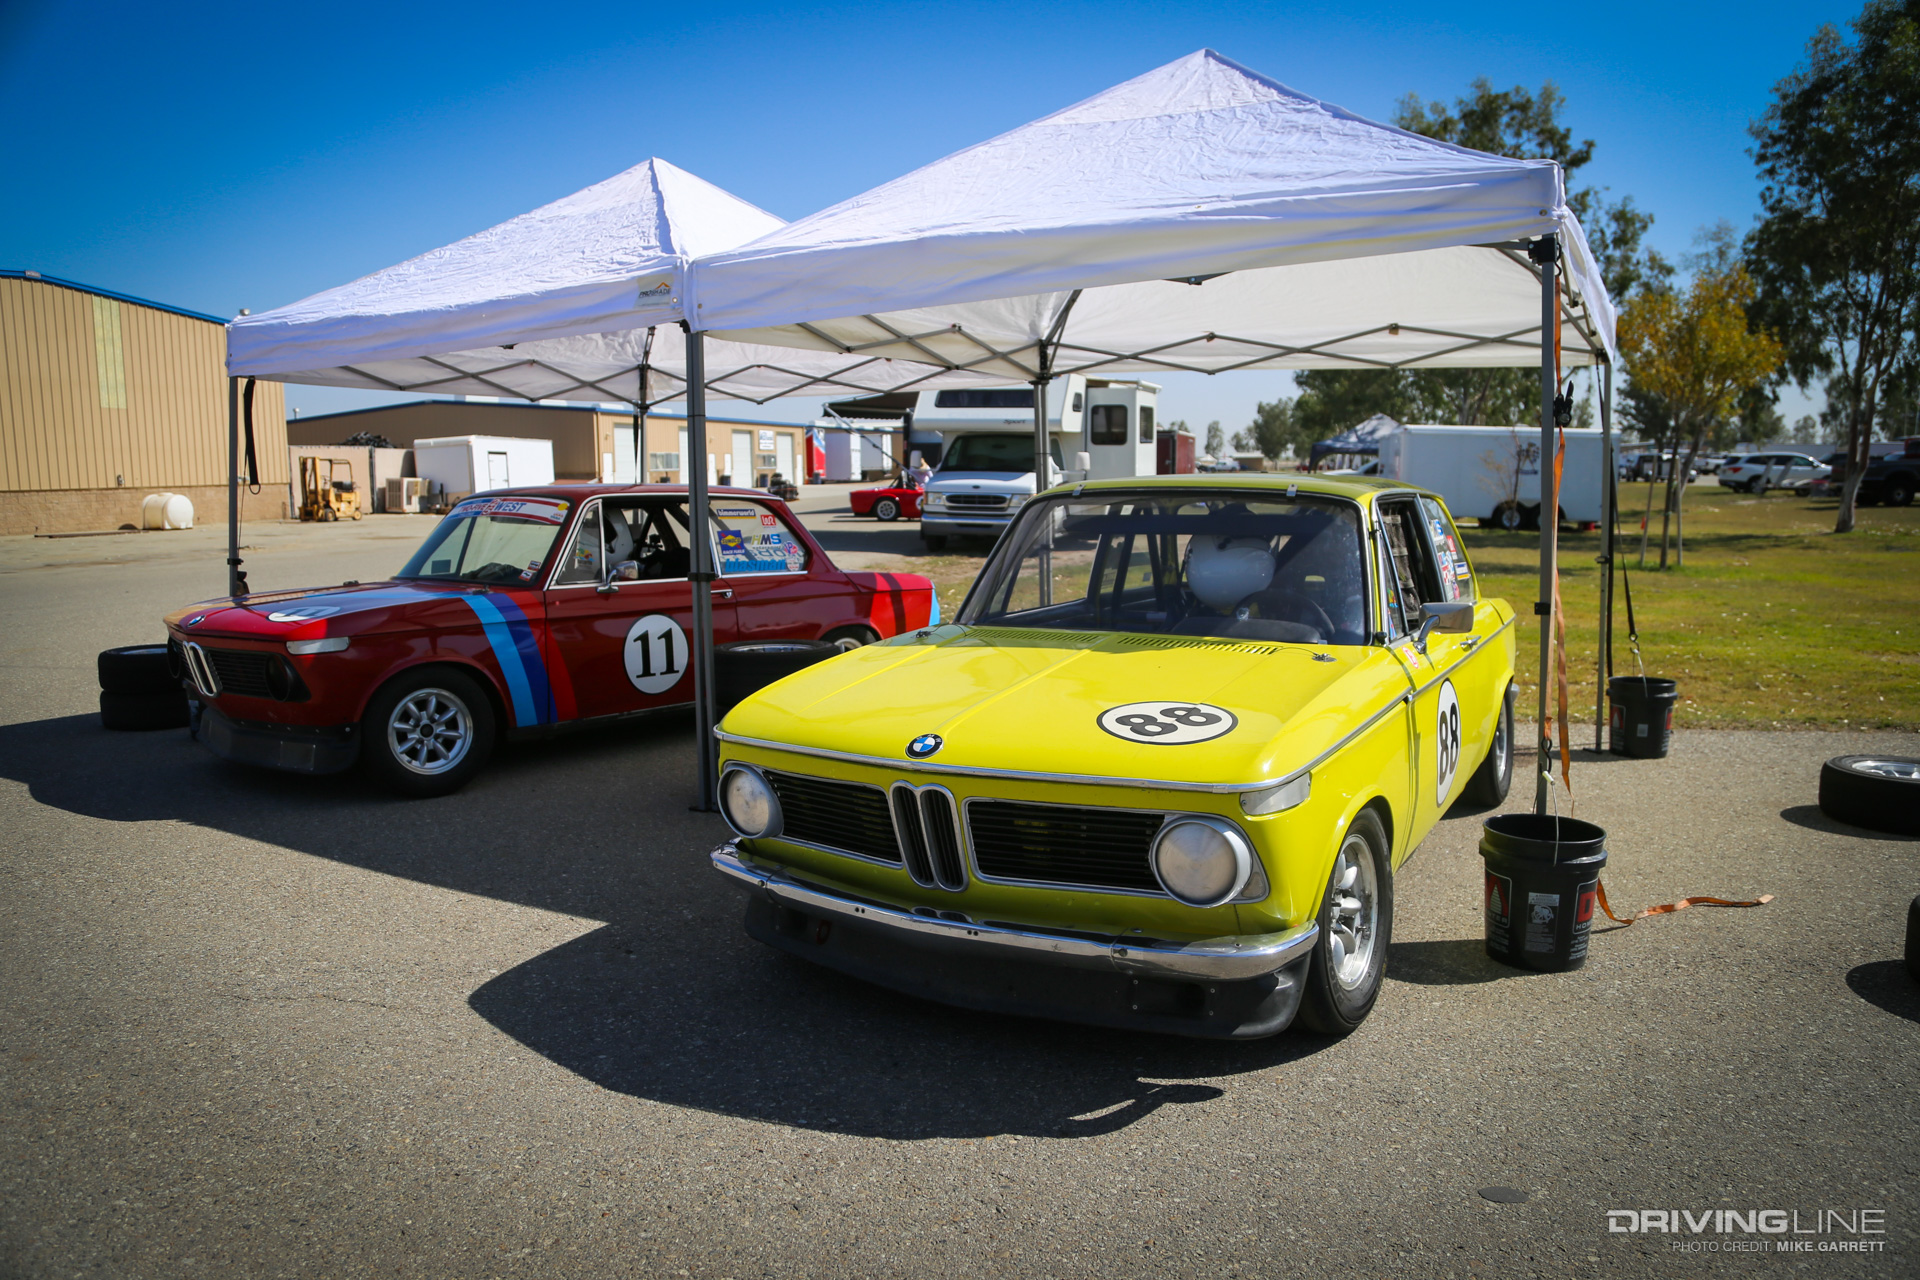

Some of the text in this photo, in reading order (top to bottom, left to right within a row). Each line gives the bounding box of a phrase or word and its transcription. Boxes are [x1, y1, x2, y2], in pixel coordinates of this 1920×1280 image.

[494, 502, 527, 512] WEST
[751, 534, 781, 545] HMS
[633, 627, 680, 678] 11
[1115, 706, 1223, 737] 88
[1439, 702, 1459, 786] 88
